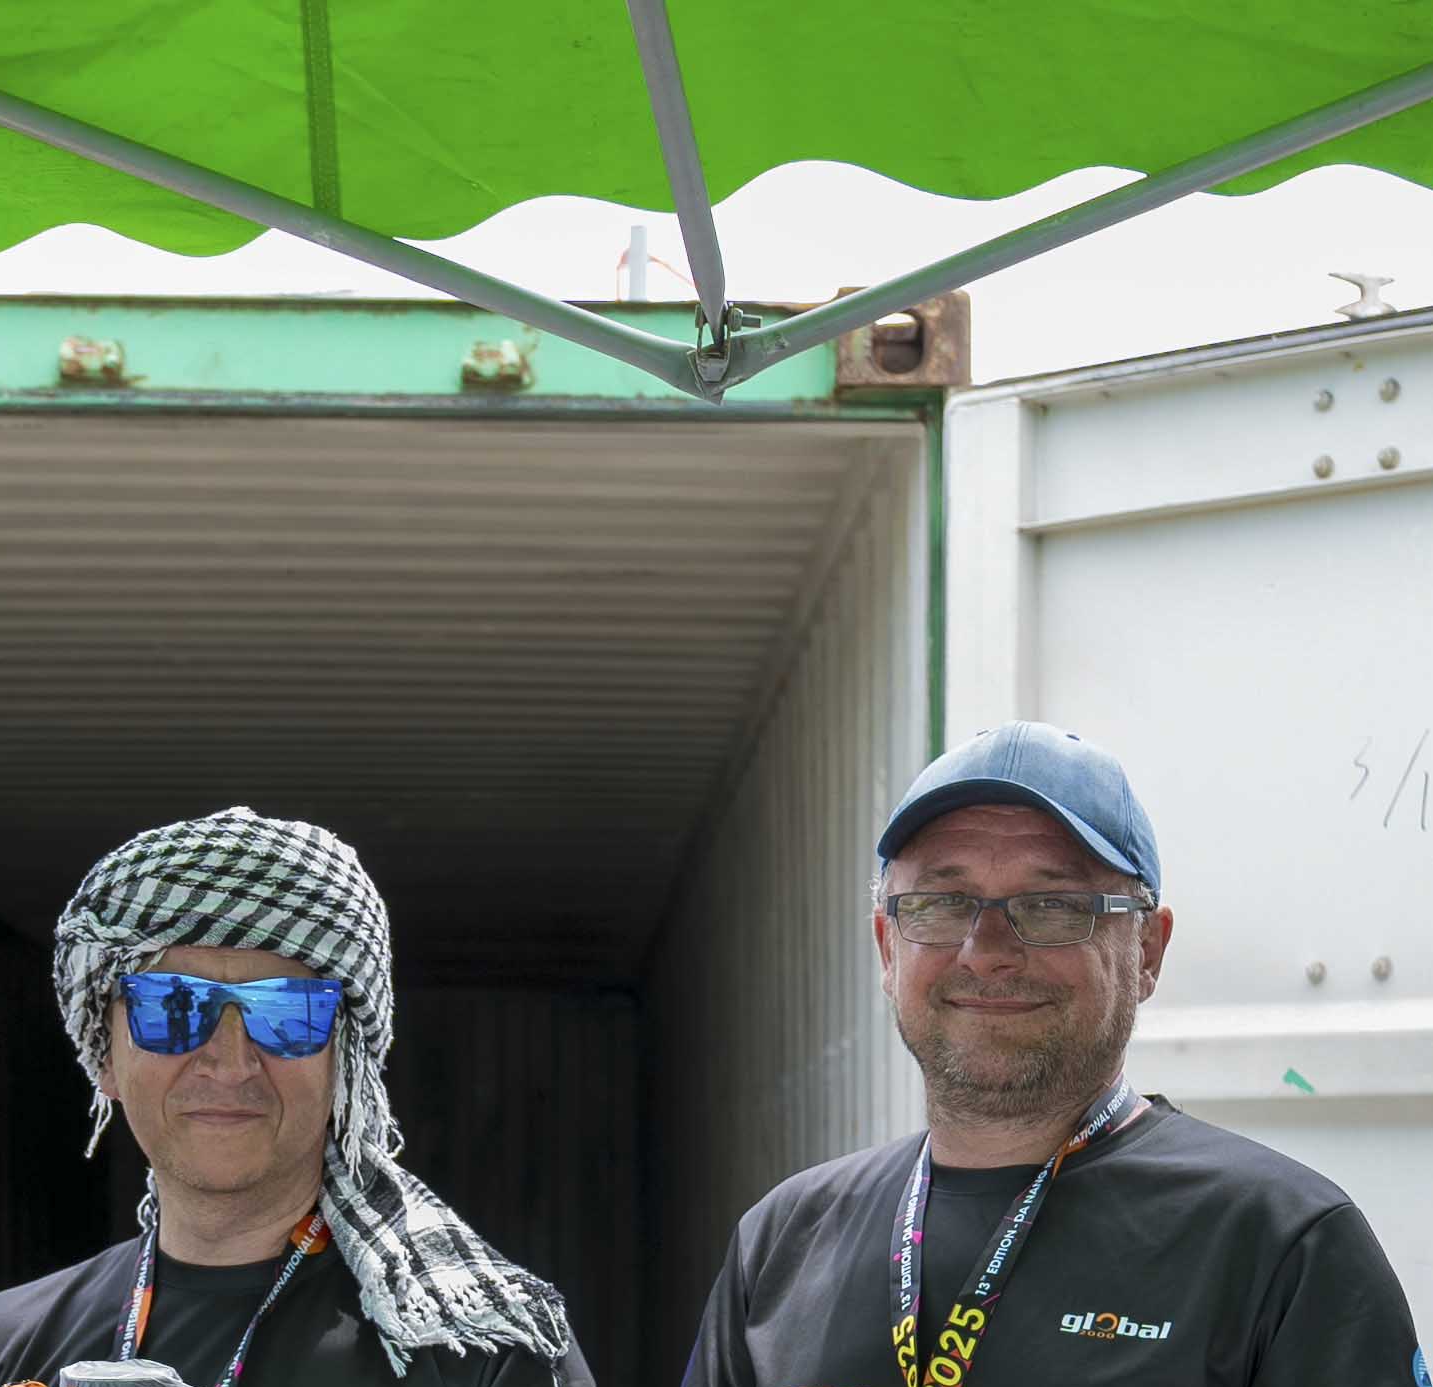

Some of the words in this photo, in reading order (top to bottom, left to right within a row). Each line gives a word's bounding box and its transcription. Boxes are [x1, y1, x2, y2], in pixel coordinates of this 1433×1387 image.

[1069, 1110, 1111, 1148] ATIONAL
[986, 1229, 1018, 1275] EDITION
[1013, 1204, 1031, 1223] DA
[1023, 1170, 1049, 1203] NANG
[901, 1250, 913, 1289] EDITION
[1059, 1312, 1173, 1339] global
